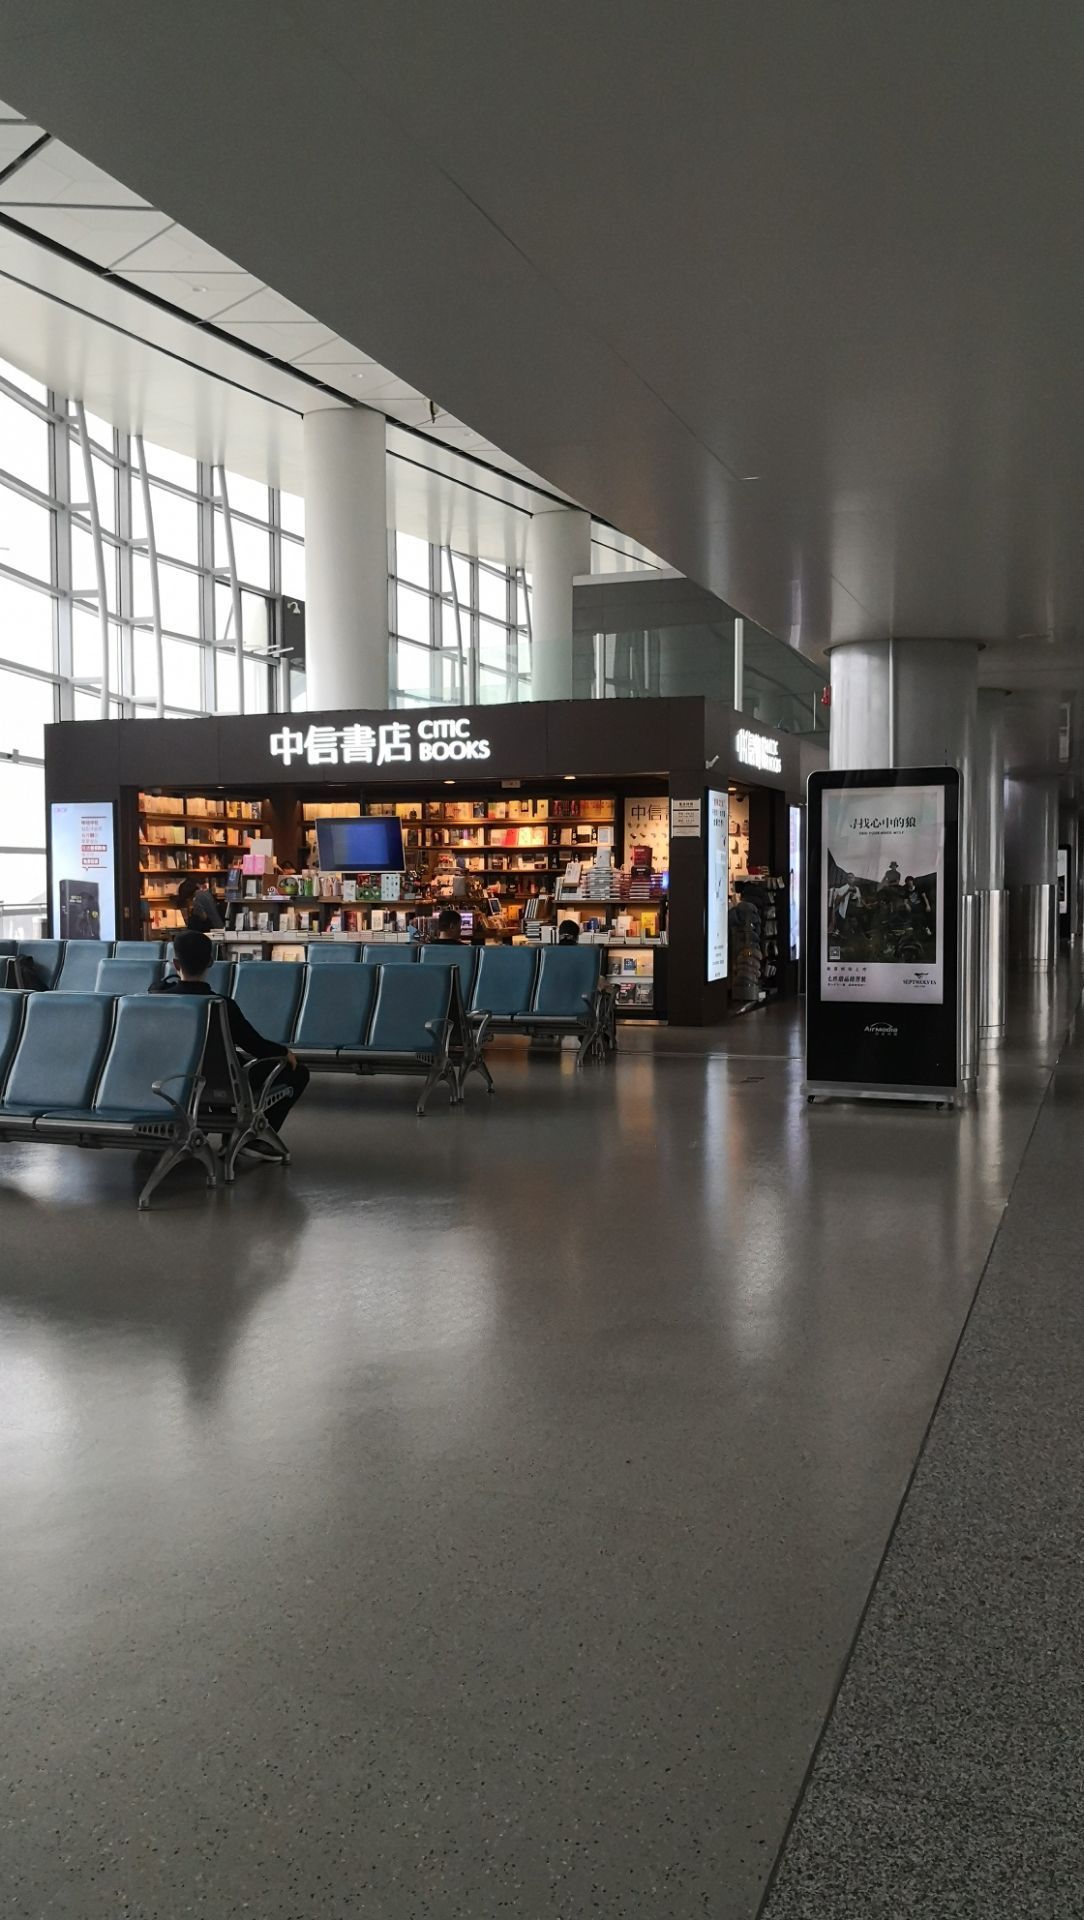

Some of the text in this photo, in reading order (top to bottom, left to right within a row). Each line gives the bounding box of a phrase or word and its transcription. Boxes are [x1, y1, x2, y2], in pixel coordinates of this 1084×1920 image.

[417, 718, 471, 739] CITIC
[270, 722, 412, 766] 中信書店
[419, 740, 490, 761] BOOKS
